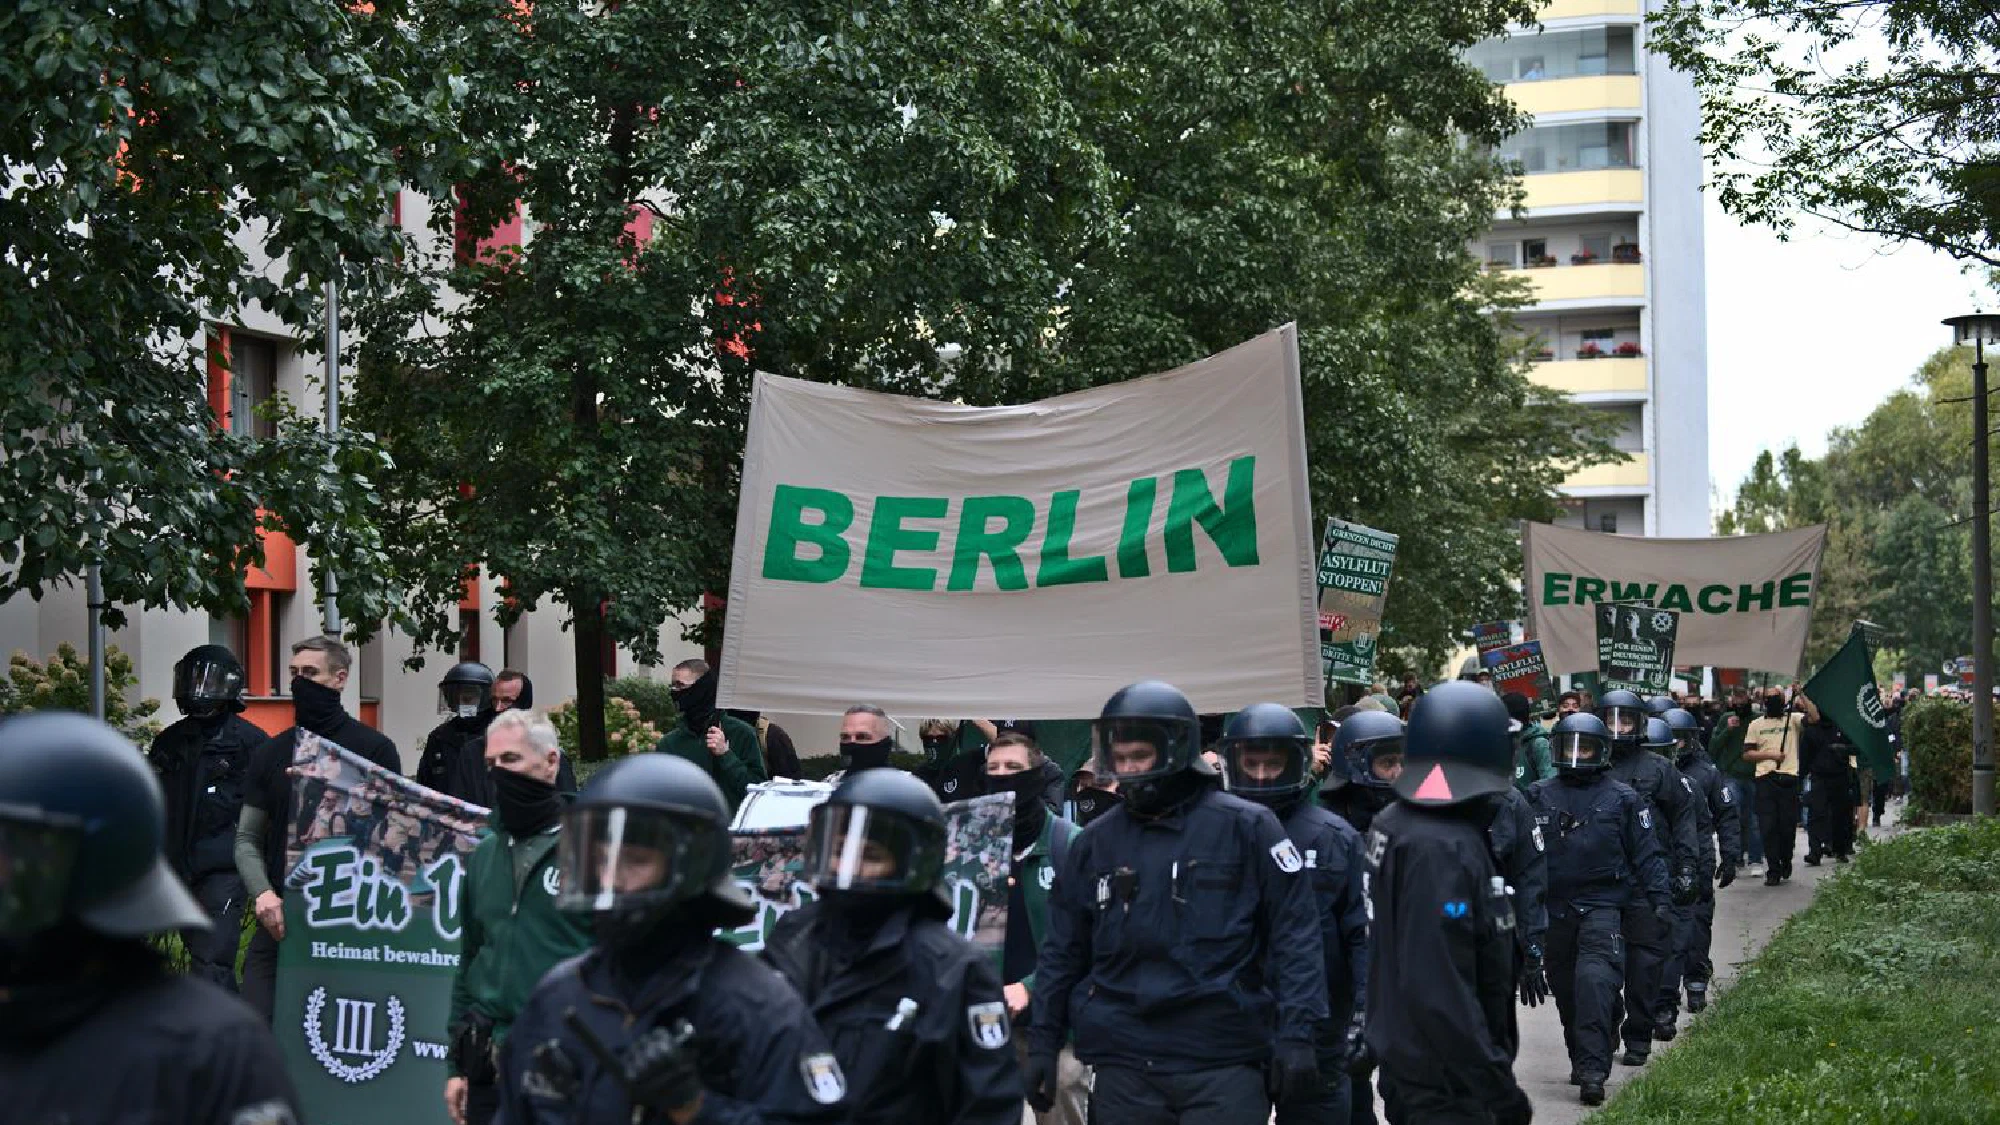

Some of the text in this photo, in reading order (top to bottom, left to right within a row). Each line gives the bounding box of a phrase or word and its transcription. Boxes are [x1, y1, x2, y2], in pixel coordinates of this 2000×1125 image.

[763, 456, 1260, 591] BERLIN
[1322, 554, 1389, 576] ASYLFLUT
[1318, 571, 1382, 593] STOPPEN!
[1543, 572, 1812, 613] ERWACHE
[1492, 655, 1541, 673] ASYLFLUT
[1495, 663, 1544, 681] STOPPEN!
[307, 848, 410, 929] Ein
[312, 942, 380, 961] Heimat
